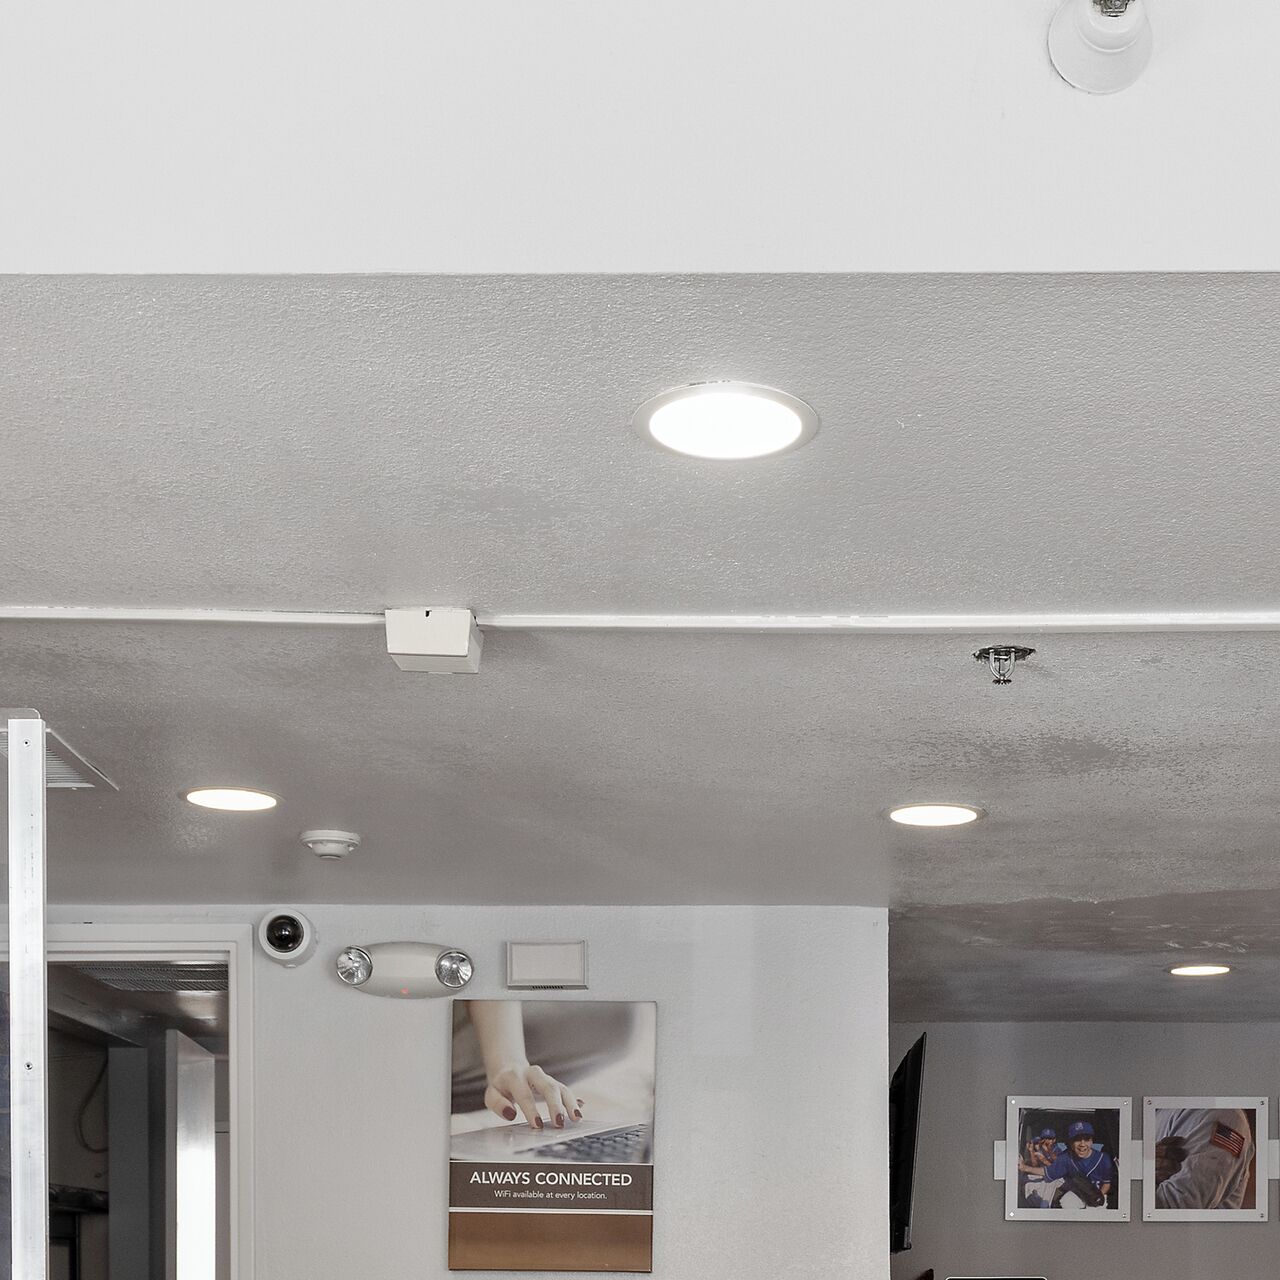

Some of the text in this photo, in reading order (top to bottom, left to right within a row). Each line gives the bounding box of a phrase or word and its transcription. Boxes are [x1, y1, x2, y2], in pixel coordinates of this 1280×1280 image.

[470, 1171, 633, 1187] ALWAYS CONNECTED
[494, 1190, 608, 1201] WiFi available at every location.
